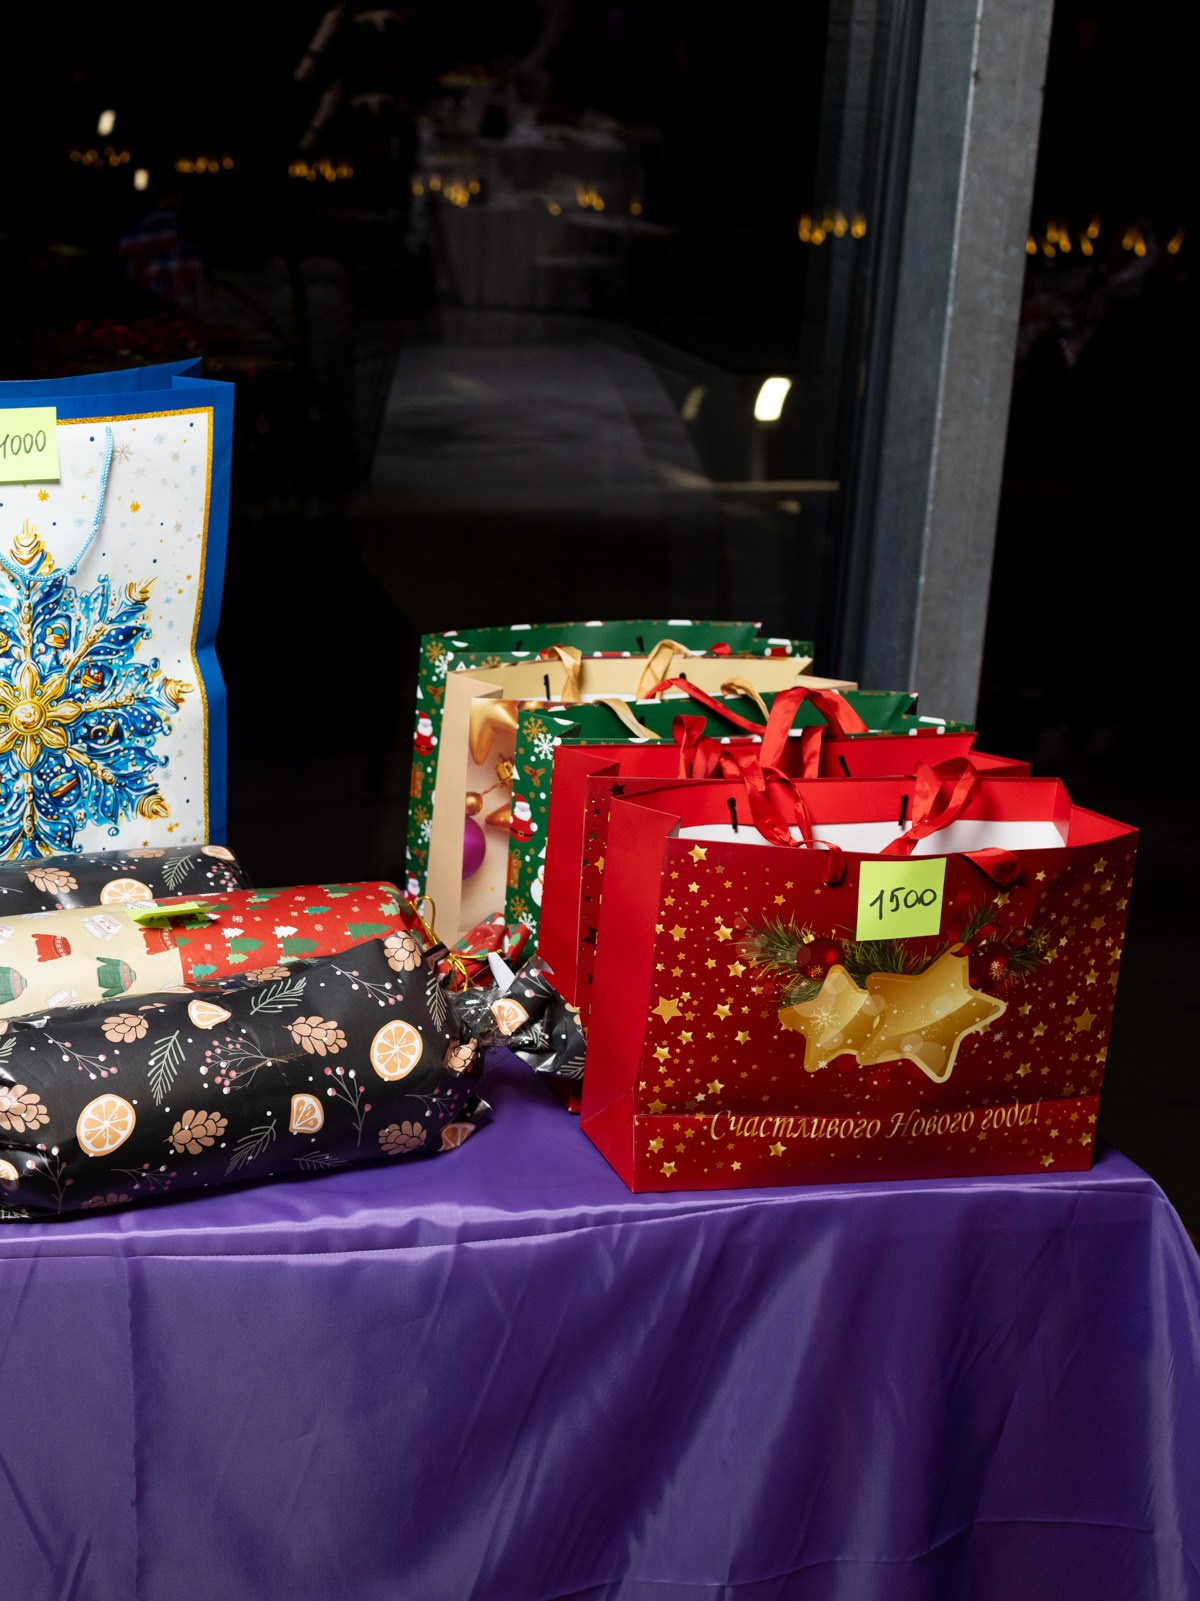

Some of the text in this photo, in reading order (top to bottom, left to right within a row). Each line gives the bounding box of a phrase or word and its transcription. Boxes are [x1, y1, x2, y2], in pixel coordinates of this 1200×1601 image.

[869, 887, 937, 920] 1500
[710, 1096, 1042, 1140] Счастливого Нового года!
